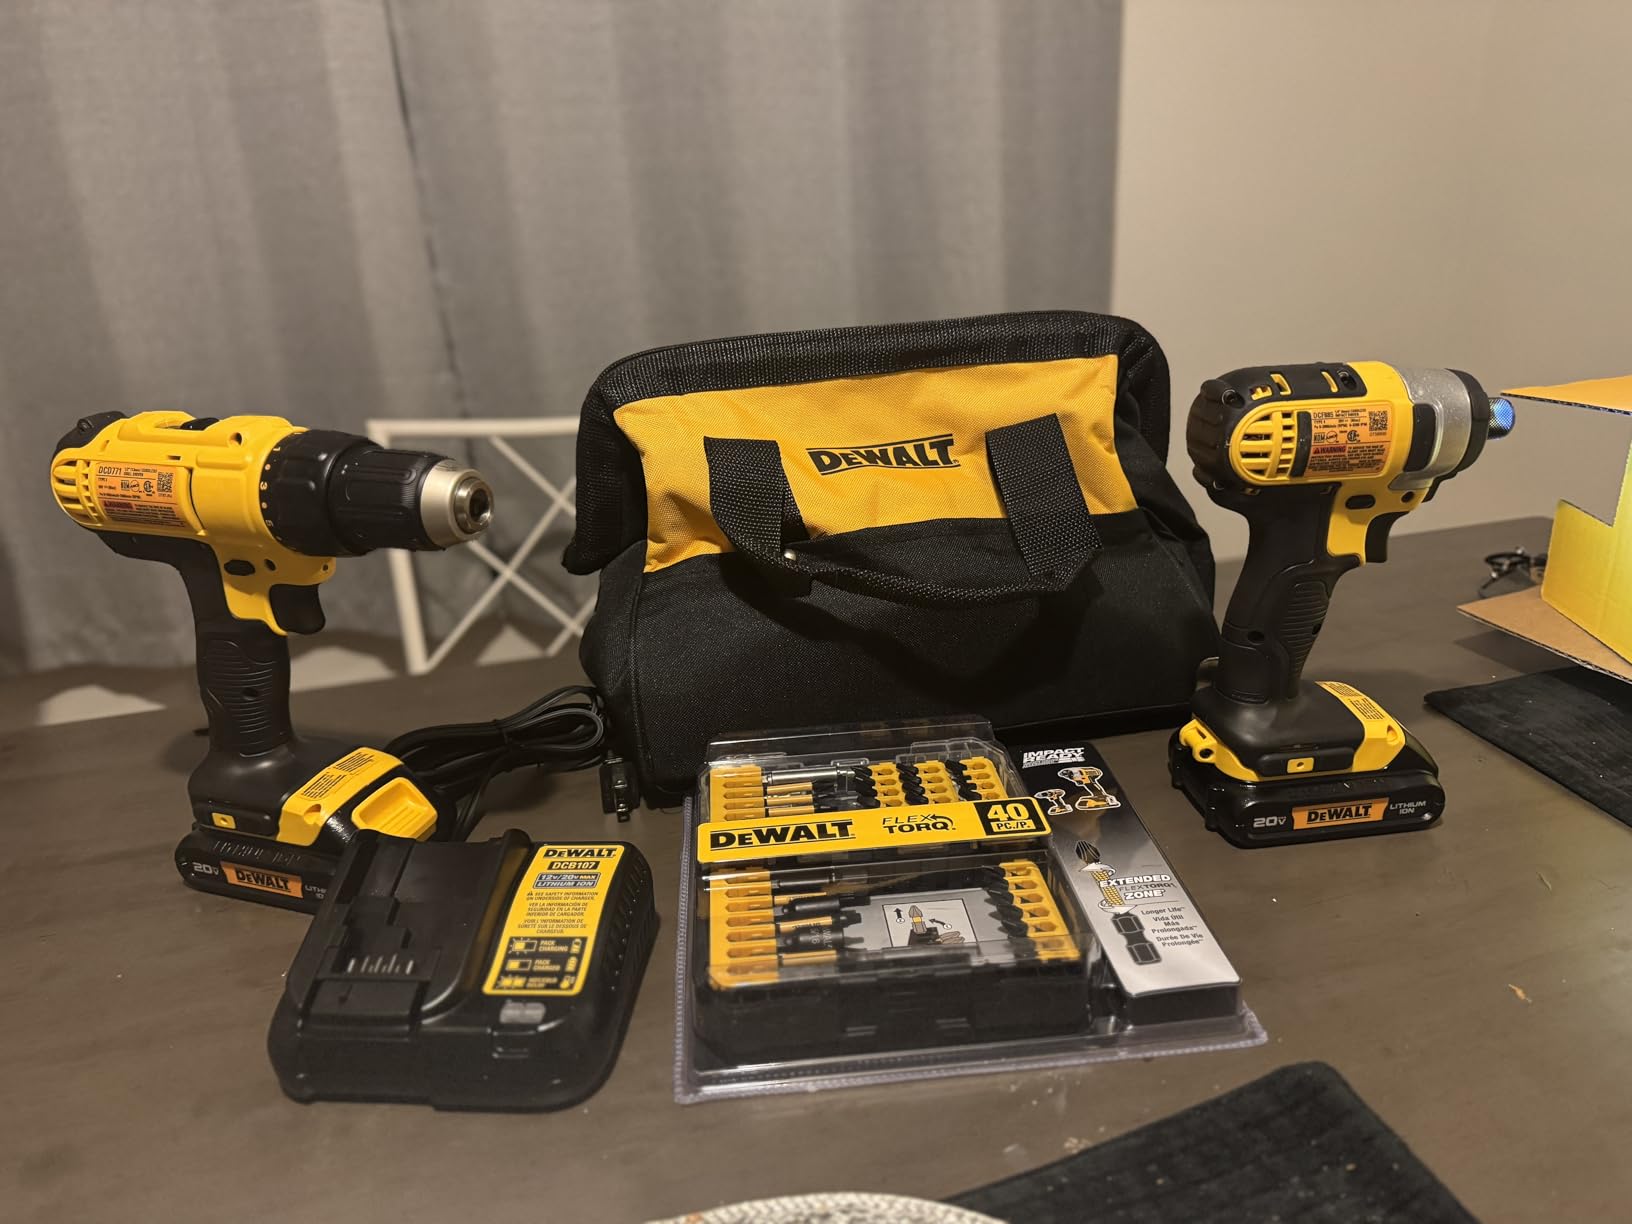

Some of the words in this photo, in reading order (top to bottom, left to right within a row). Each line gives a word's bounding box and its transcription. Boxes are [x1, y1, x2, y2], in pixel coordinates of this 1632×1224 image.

[807, 437, 954, 474] DEWALT
[98, 466, 122, 476] DCD771
[1023, 747, 1085, 758] IMPACT
[987, 804, 1031, 822] 40
[1306, 804, 1373, 823] DEWALT
[1389, 800, 1427, 810] LITHIUM
[1399, 807, 1415, 815] ION
[882, 813, 931, 825] FLEX
[709, 823, 857, 850] DEWALT
[543, 848, 617, 859] DEWALT
[552, 861, 597, 870] DCB107
[235, 867, 290, 891] DEWALT
[537, 880, 575, 888] LITHIUM
[576, 880, 594, 888] ION
[1099, 874, 1172, 888] EXTENDED
[1141, 908, 1167, 916] Longer
